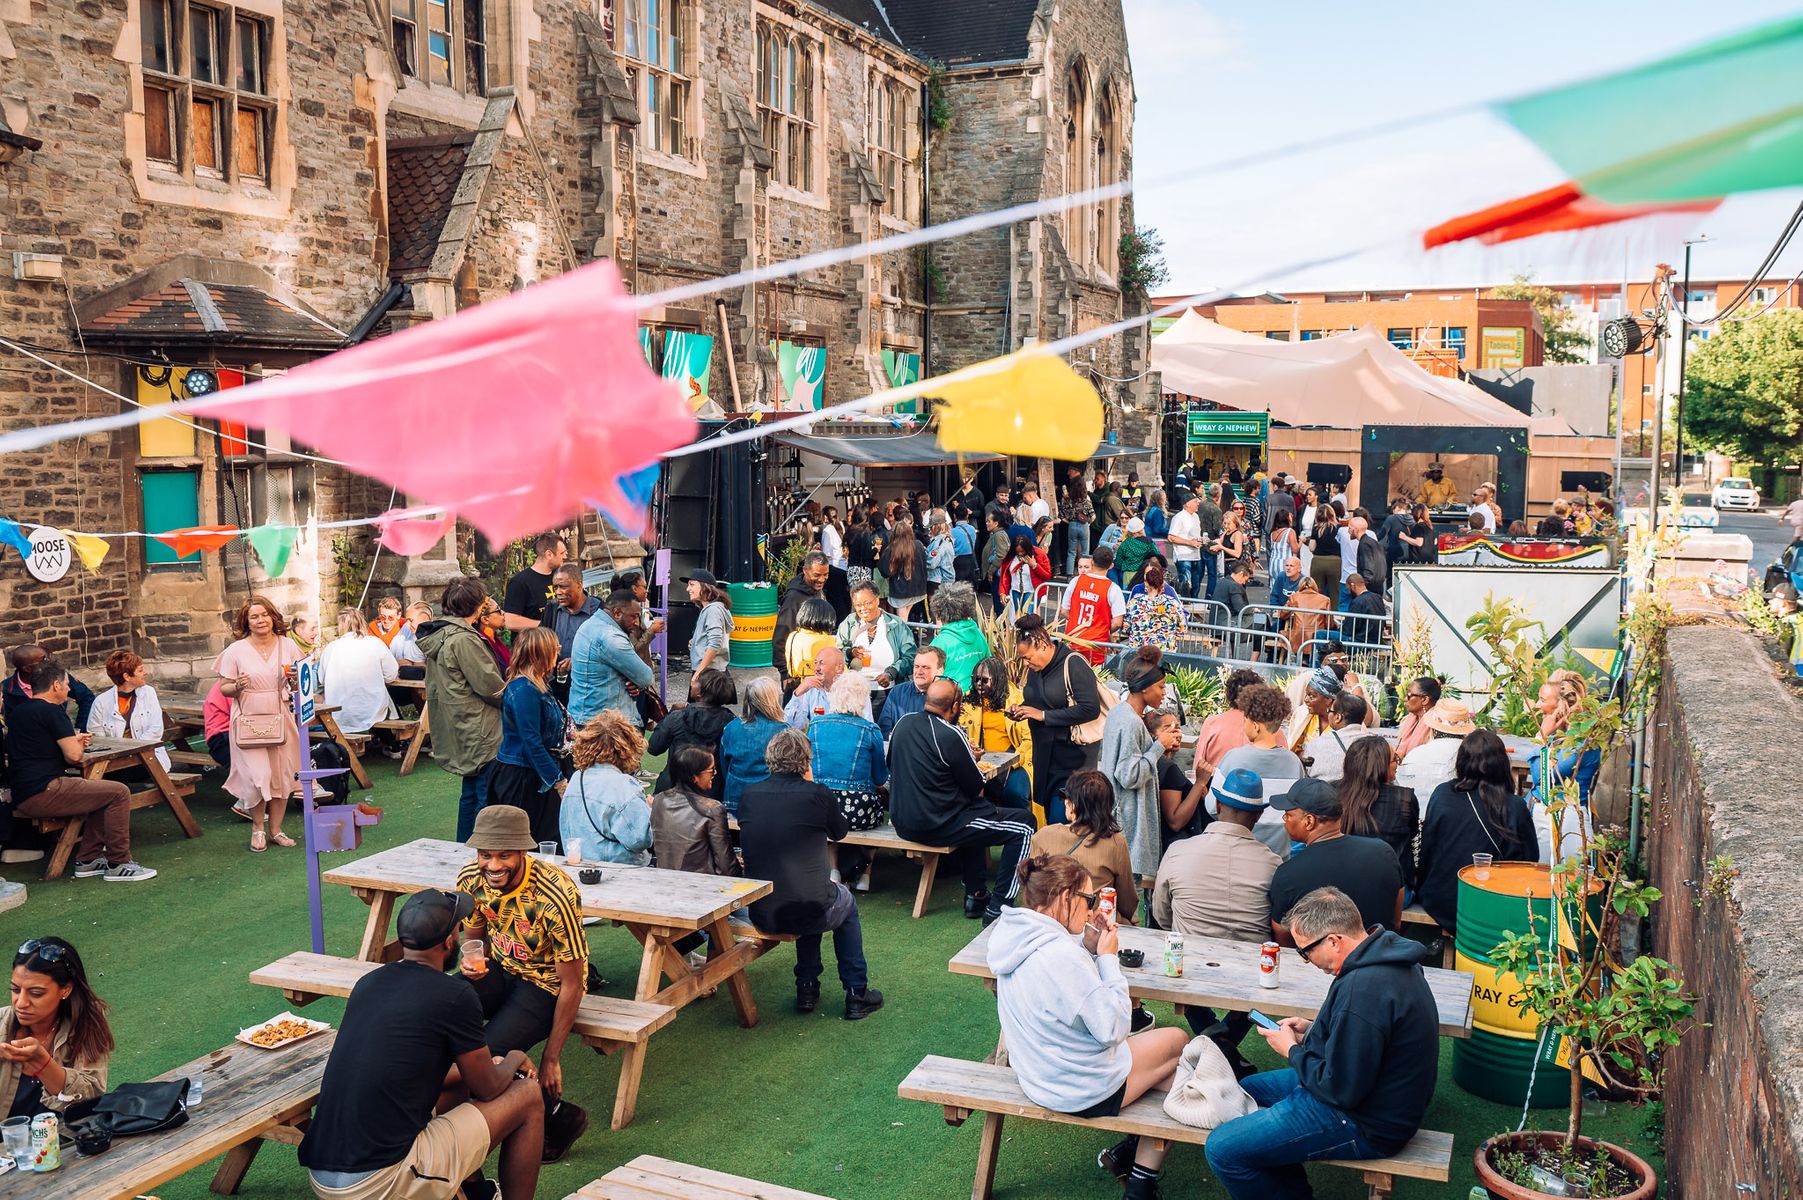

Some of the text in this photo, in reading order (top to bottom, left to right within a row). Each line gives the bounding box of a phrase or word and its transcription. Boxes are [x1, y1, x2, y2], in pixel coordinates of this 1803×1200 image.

[1195, 424, 1257, 432] WRAY & NEPHEW
[1077, 602, 1095, 628] 13
[749, 625, 774, 633] NEPHEW
[1170, 941, 1184, 951] INCH
[1474, 984, 1522, 1008] RAY &
